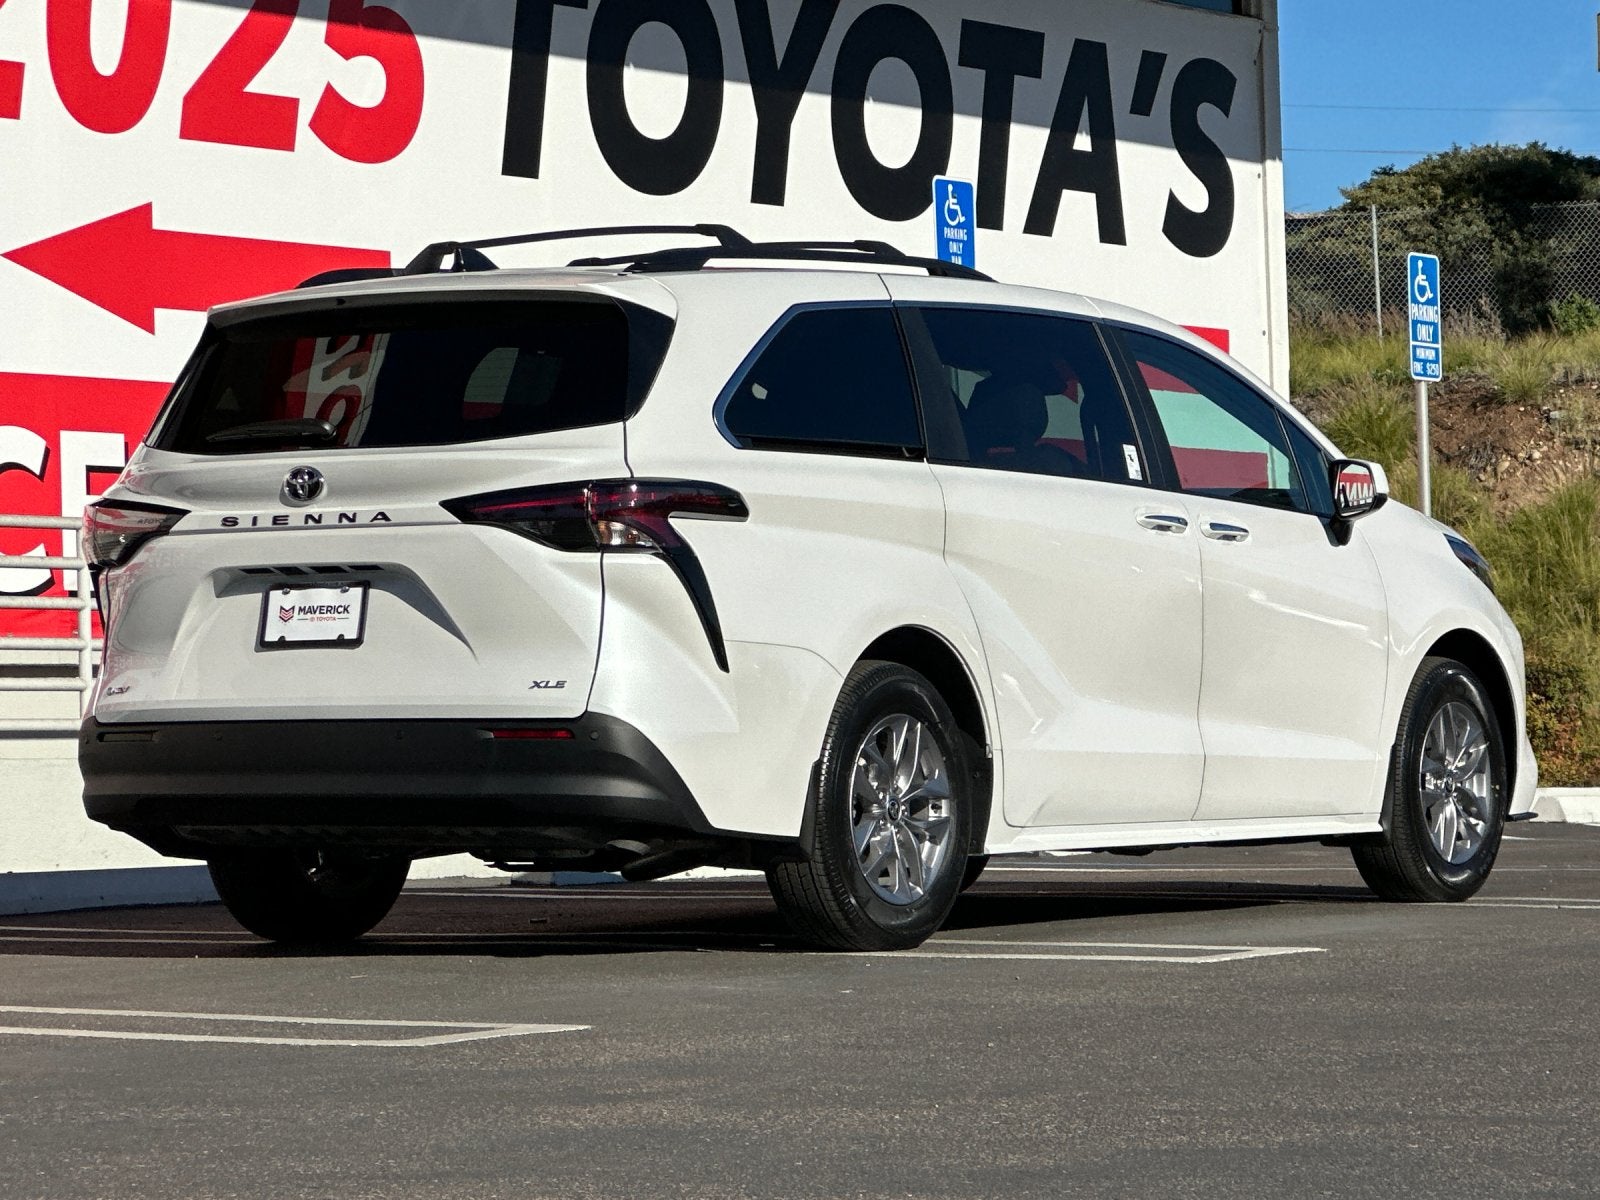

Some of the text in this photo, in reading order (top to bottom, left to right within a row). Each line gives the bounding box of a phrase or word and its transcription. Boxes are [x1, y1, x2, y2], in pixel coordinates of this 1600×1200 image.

[0, 0, 1237, 258] 025 TOYOTA'S
[943, 226, 968, 241] PARKING
[948, 241, 963, 255] ONLY
[1411, 303, 1438, 323] PARKING
[1416, 323, 1434, 342] ONLY
[1413, 361, 1439, 376] FINE $250
[221, 511, 392, 527] SIENNA
[298, 604, 351, 616] MAVERICK
[528, 680, 567, 690] XLE
